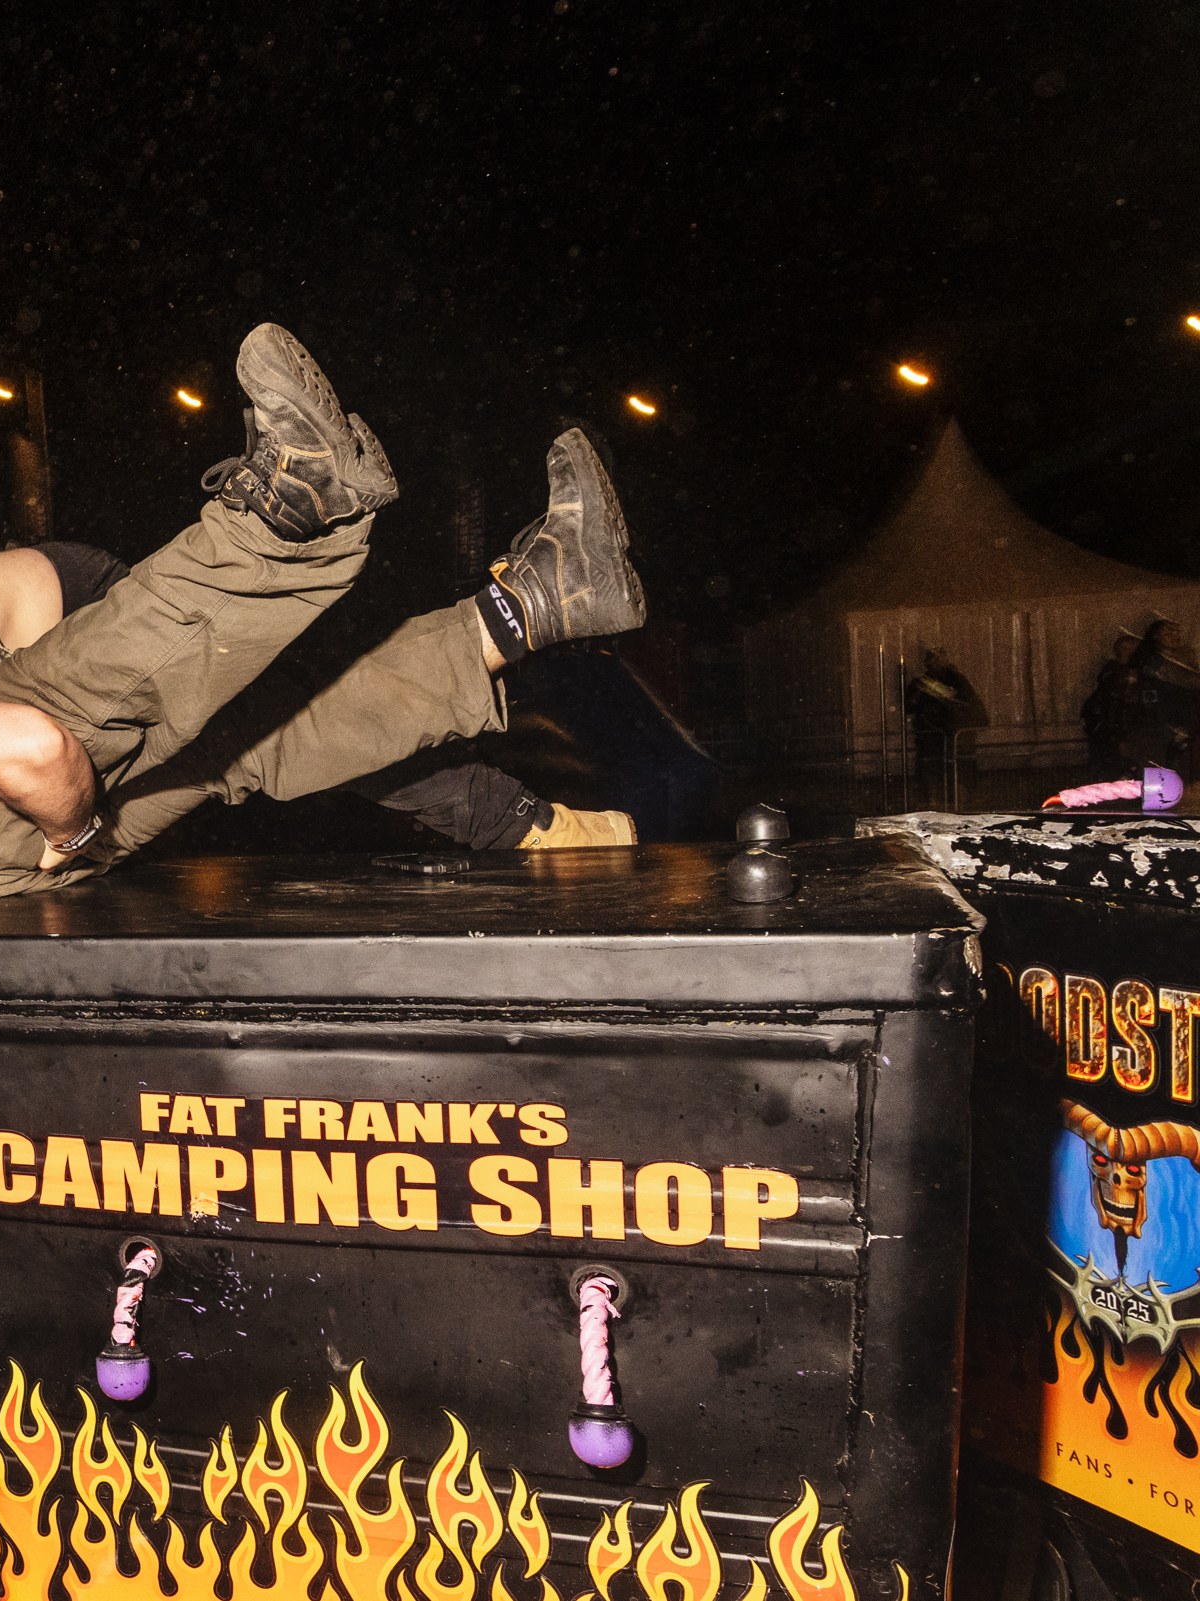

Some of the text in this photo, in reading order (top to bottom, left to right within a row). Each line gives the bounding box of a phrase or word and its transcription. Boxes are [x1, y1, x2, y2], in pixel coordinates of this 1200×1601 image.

[488, 583, 524, 639] JCB
[62, 817, 92, 848] BLOODSTO
[140, 1092, 569, 1148] FAT FRANK'S
[468, 1153, 801, 1251] SHOP
[1095, 1288, 1150, 1322] 20 25
[1056, 1442, 1196, 1517] FANS FOR
